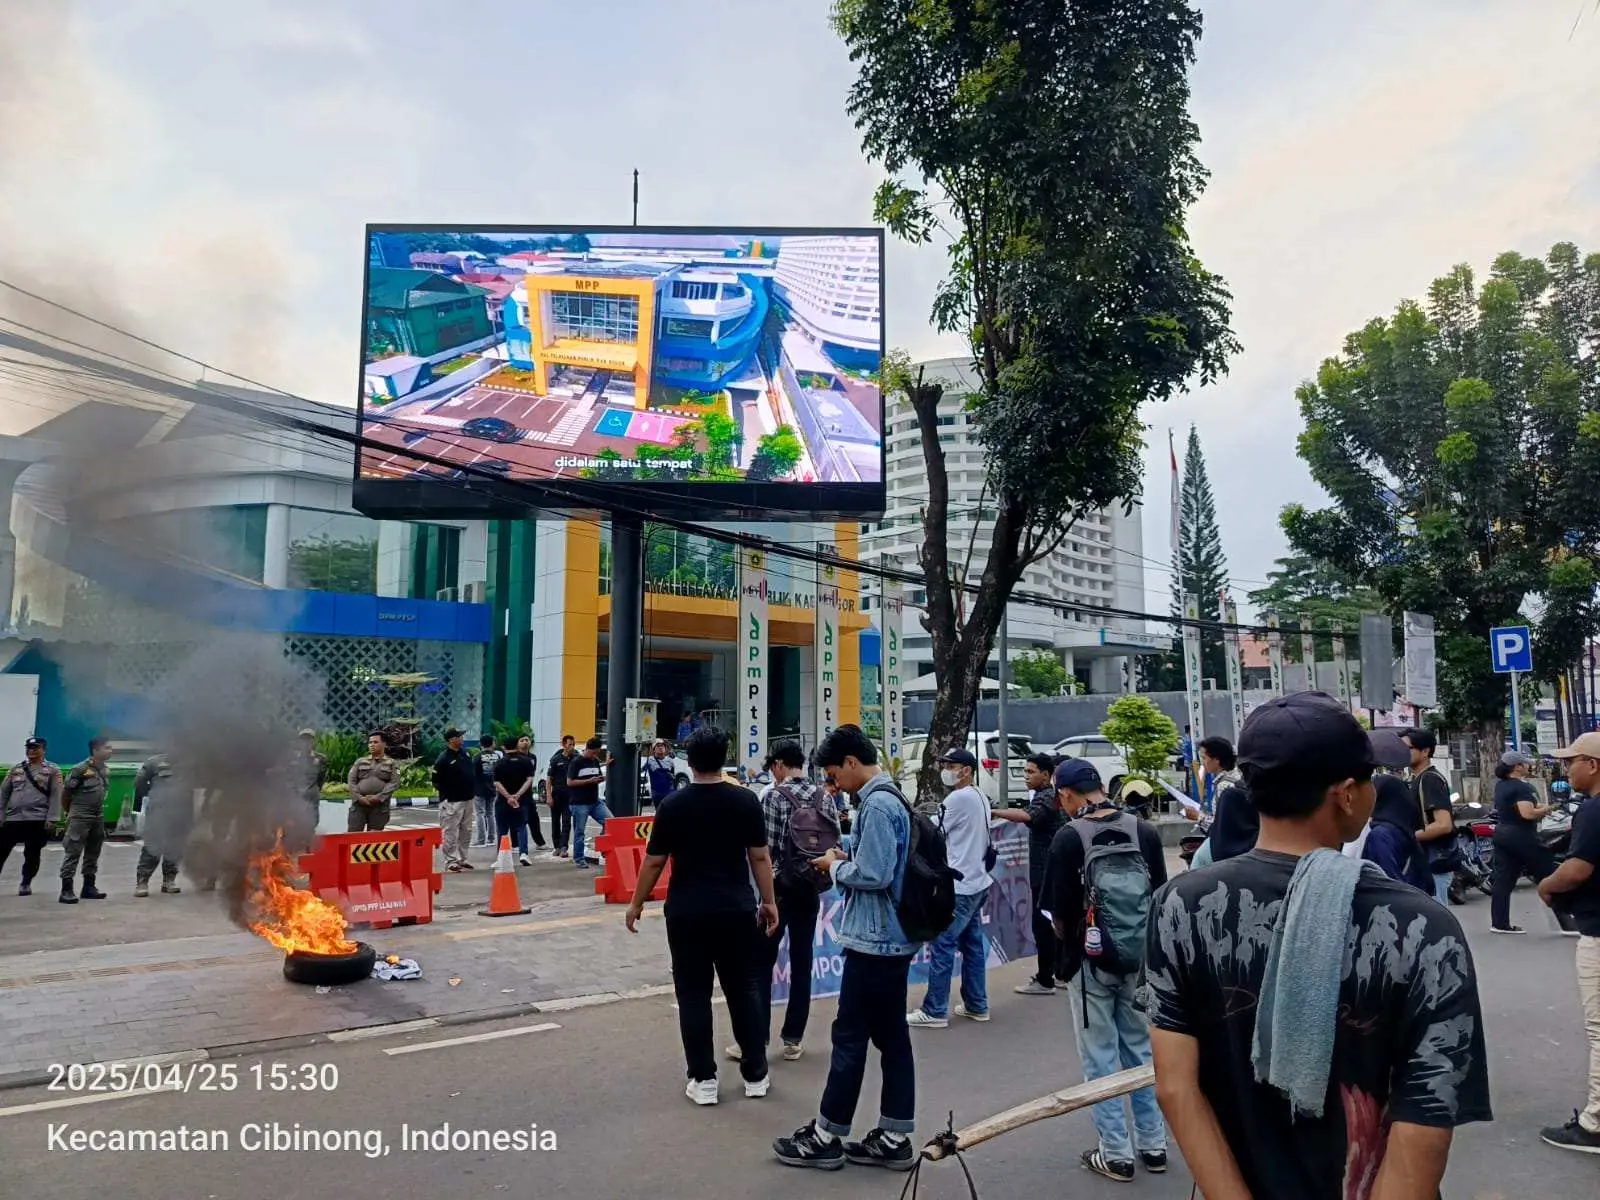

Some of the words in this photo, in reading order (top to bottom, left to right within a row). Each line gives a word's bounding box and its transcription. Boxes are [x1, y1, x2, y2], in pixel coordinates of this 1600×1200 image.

[575, 279, 600, 290] MPP
[554, 456, 608, 468] didalam
[645, 457, 693, 471] tempat
[823, 619, 833, 738] dpmpts
[1496, 633, 1524, 666] P
[747, 612, 762, 758] dpmptsp
[1191, 652, 1200, 738] dpmpts
